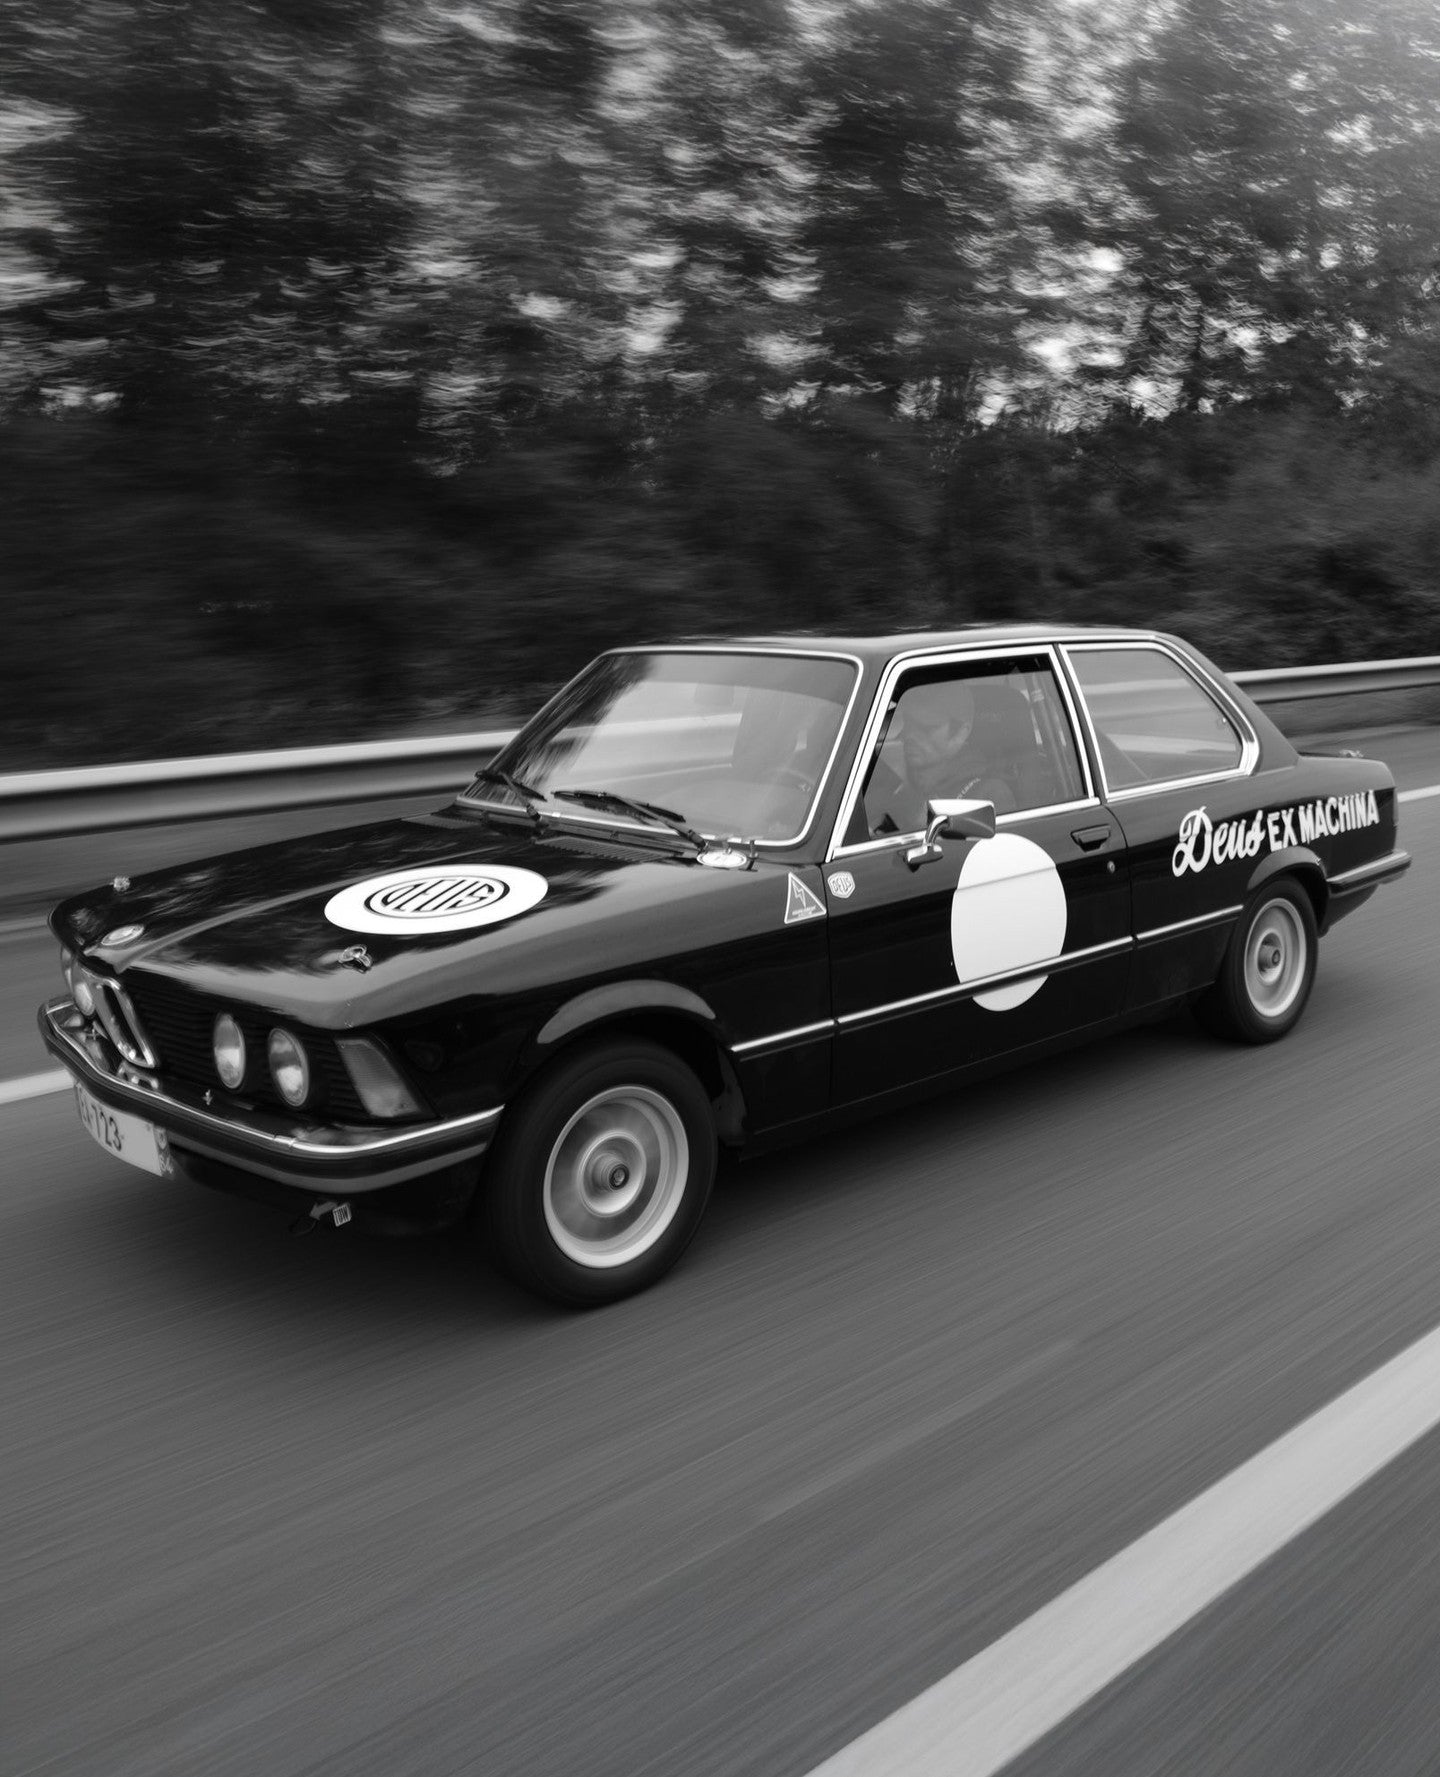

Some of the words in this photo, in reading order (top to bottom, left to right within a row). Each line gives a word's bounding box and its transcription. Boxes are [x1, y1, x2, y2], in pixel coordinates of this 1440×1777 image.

[1172, 806, 1265, 877] Deus
[1267, 807, 1298, 852] EX
[1298, 789, 1380, 844] MACHINA
[381, 879, 495, 912] DEUS
